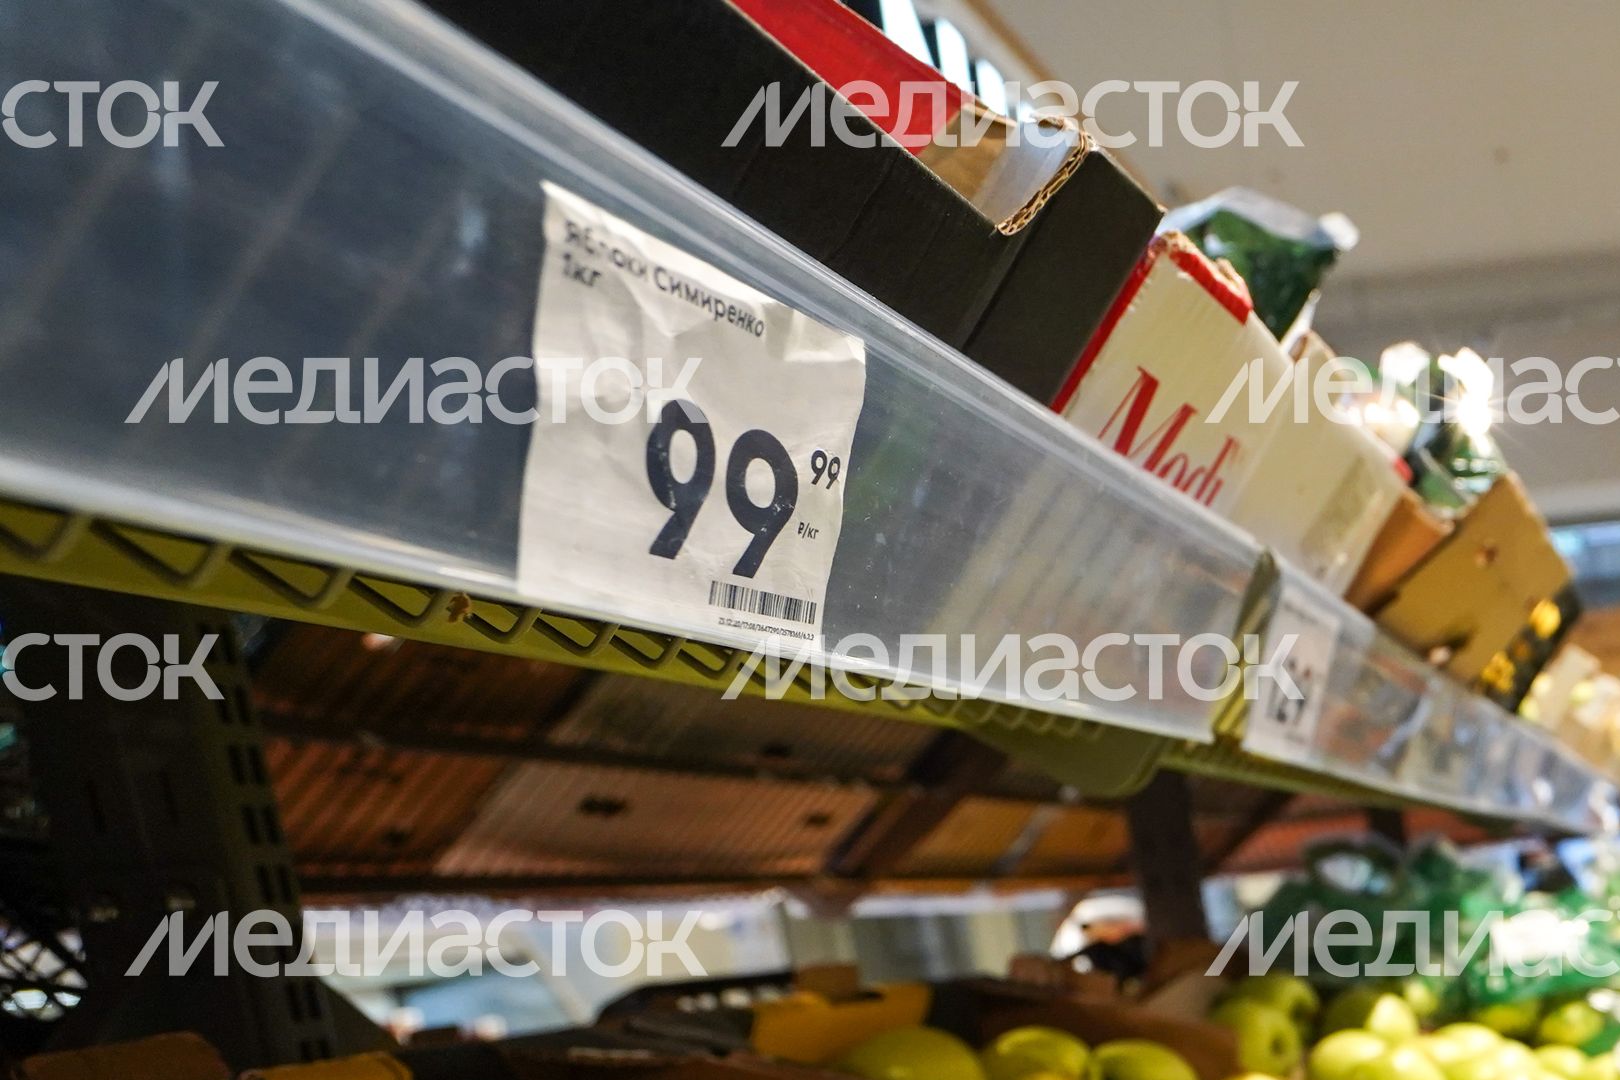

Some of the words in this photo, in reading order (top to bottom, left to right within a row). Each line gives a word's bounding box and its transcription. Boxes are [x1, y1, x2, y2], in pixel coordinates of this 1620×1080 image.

[563, 219, 648, 277] Ябоки
[653, 265, 766, 338] Симиренко
[646, 399, 798, 579] 99
[811, 449, 841, 490] 99
